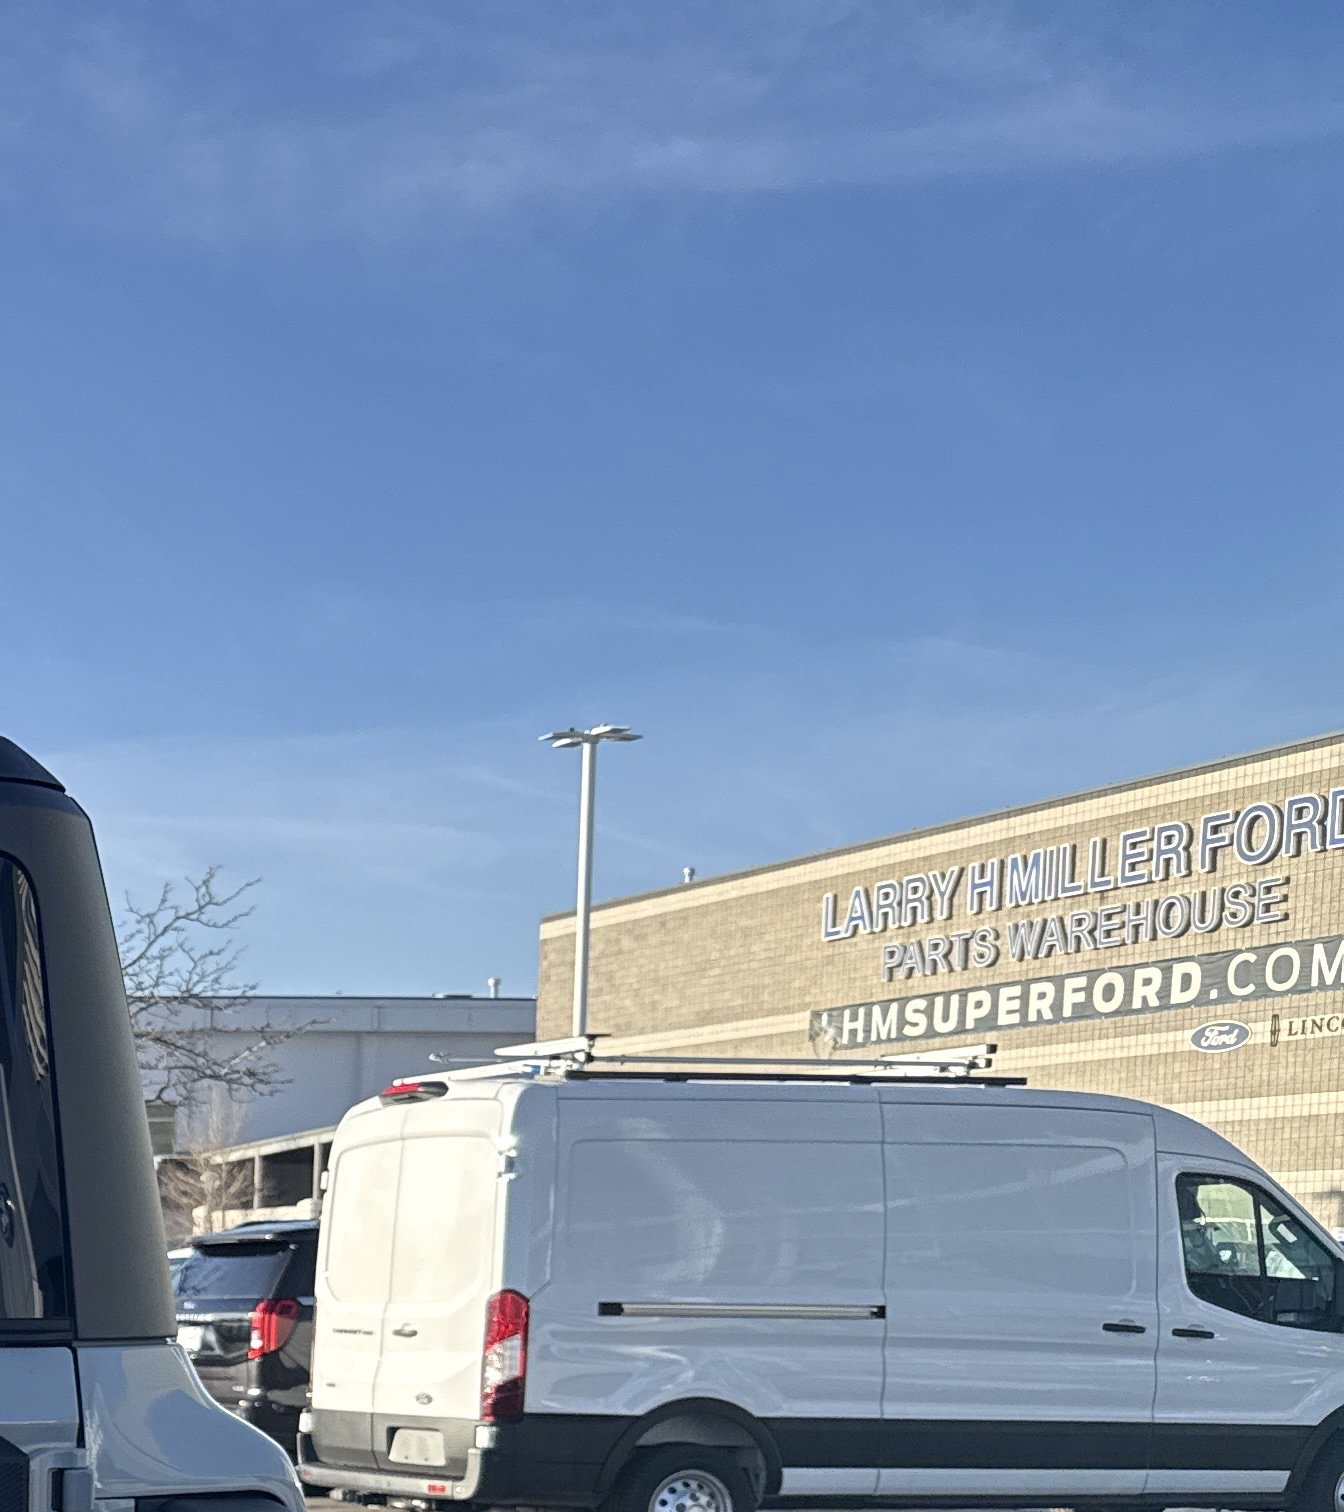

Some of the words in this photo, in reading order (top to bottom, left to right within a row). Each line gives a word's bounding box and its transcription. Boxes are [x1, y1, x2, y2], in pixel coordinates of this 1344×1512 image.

[822, 866, 962, 941] LARRY
[967, 858, 1001, 915] H
[1005, 821, 1189, 909] MILLER
[882, 927, 999, 982] PARTS
[1007, 876, 1290, 962] WAREHOUSE
[1200, 1025, 1239, 1047] Ford
[1287, 1015, 1344, 1037] LINC
